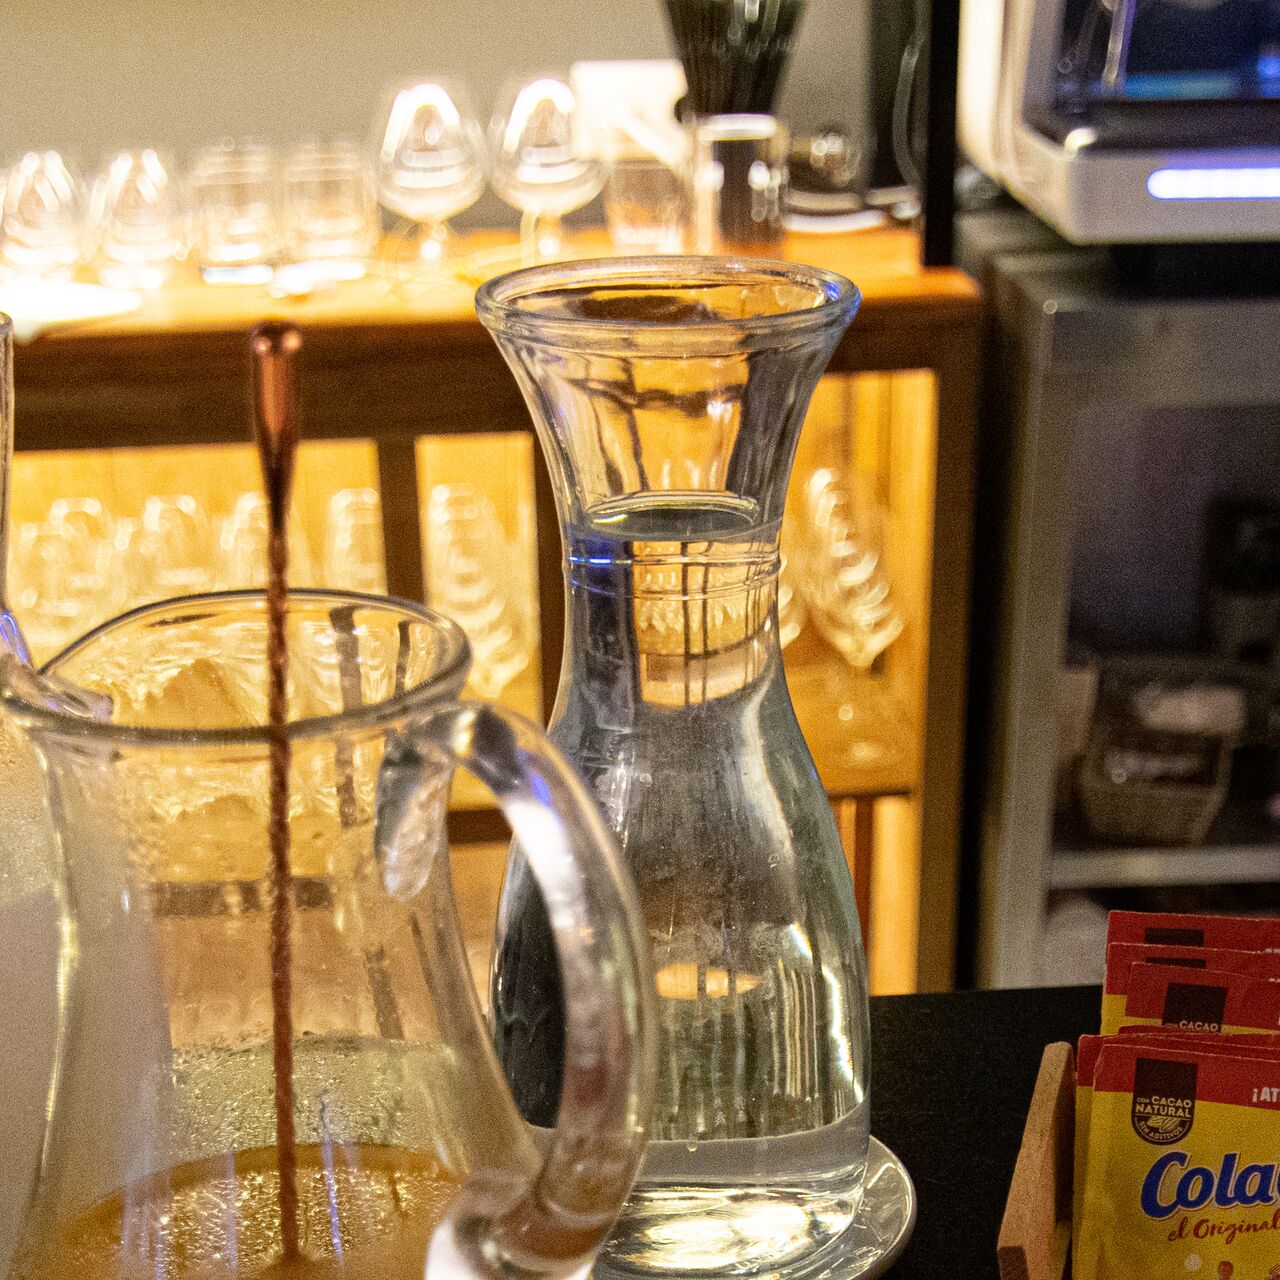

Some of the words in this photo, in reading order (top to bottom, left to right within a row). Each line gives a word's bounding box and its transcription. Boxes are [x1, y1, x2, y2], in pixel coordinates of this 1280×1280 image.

[1179, 1020, 1219, 1032] CACAO
[1151, 1095, 1192, 1108] CACAO
[1135, 1103, 1192, 1118] NATURAL
[1138, 1121, 1151, 1136] SIN
[1168, 1216, 1190, 1242] el
